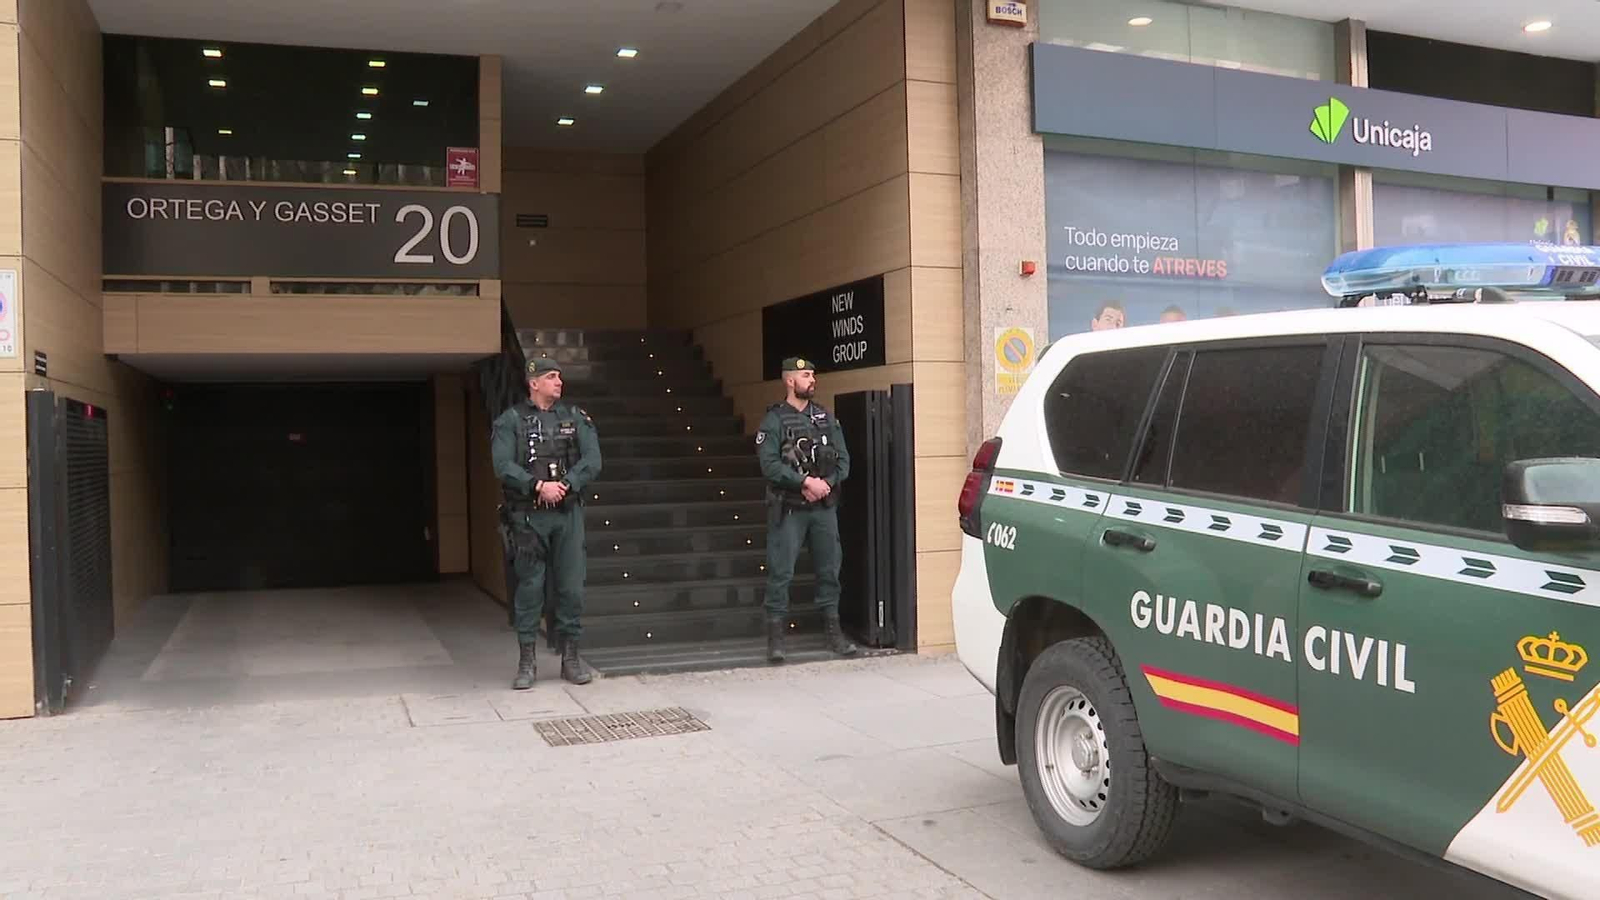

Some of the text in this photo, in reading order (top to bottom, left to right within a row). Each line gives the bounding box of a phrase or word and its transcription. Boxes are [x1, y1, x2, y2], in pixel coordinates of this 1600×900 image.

[995, 6, 1023, 16] BOSCH
[1353, 117, 1432, 157] Unicaja
[127, 198, 381, 224] ORTEGA Y GASSET
[394, 204, 480, 265] 20
[1064, 226, 1179, 253] Todo empieza
[1065, 254, 1228, 278] cuando te ATREVES
[831, 290, 854, 314] NEW
[831, 315, 864, 338] WINDS
[832, 340, 868, 363] GROUP
[993, 523, 1017, 551] 062
[1130, 590, 1416, 694] GUARDIA CIVIL
